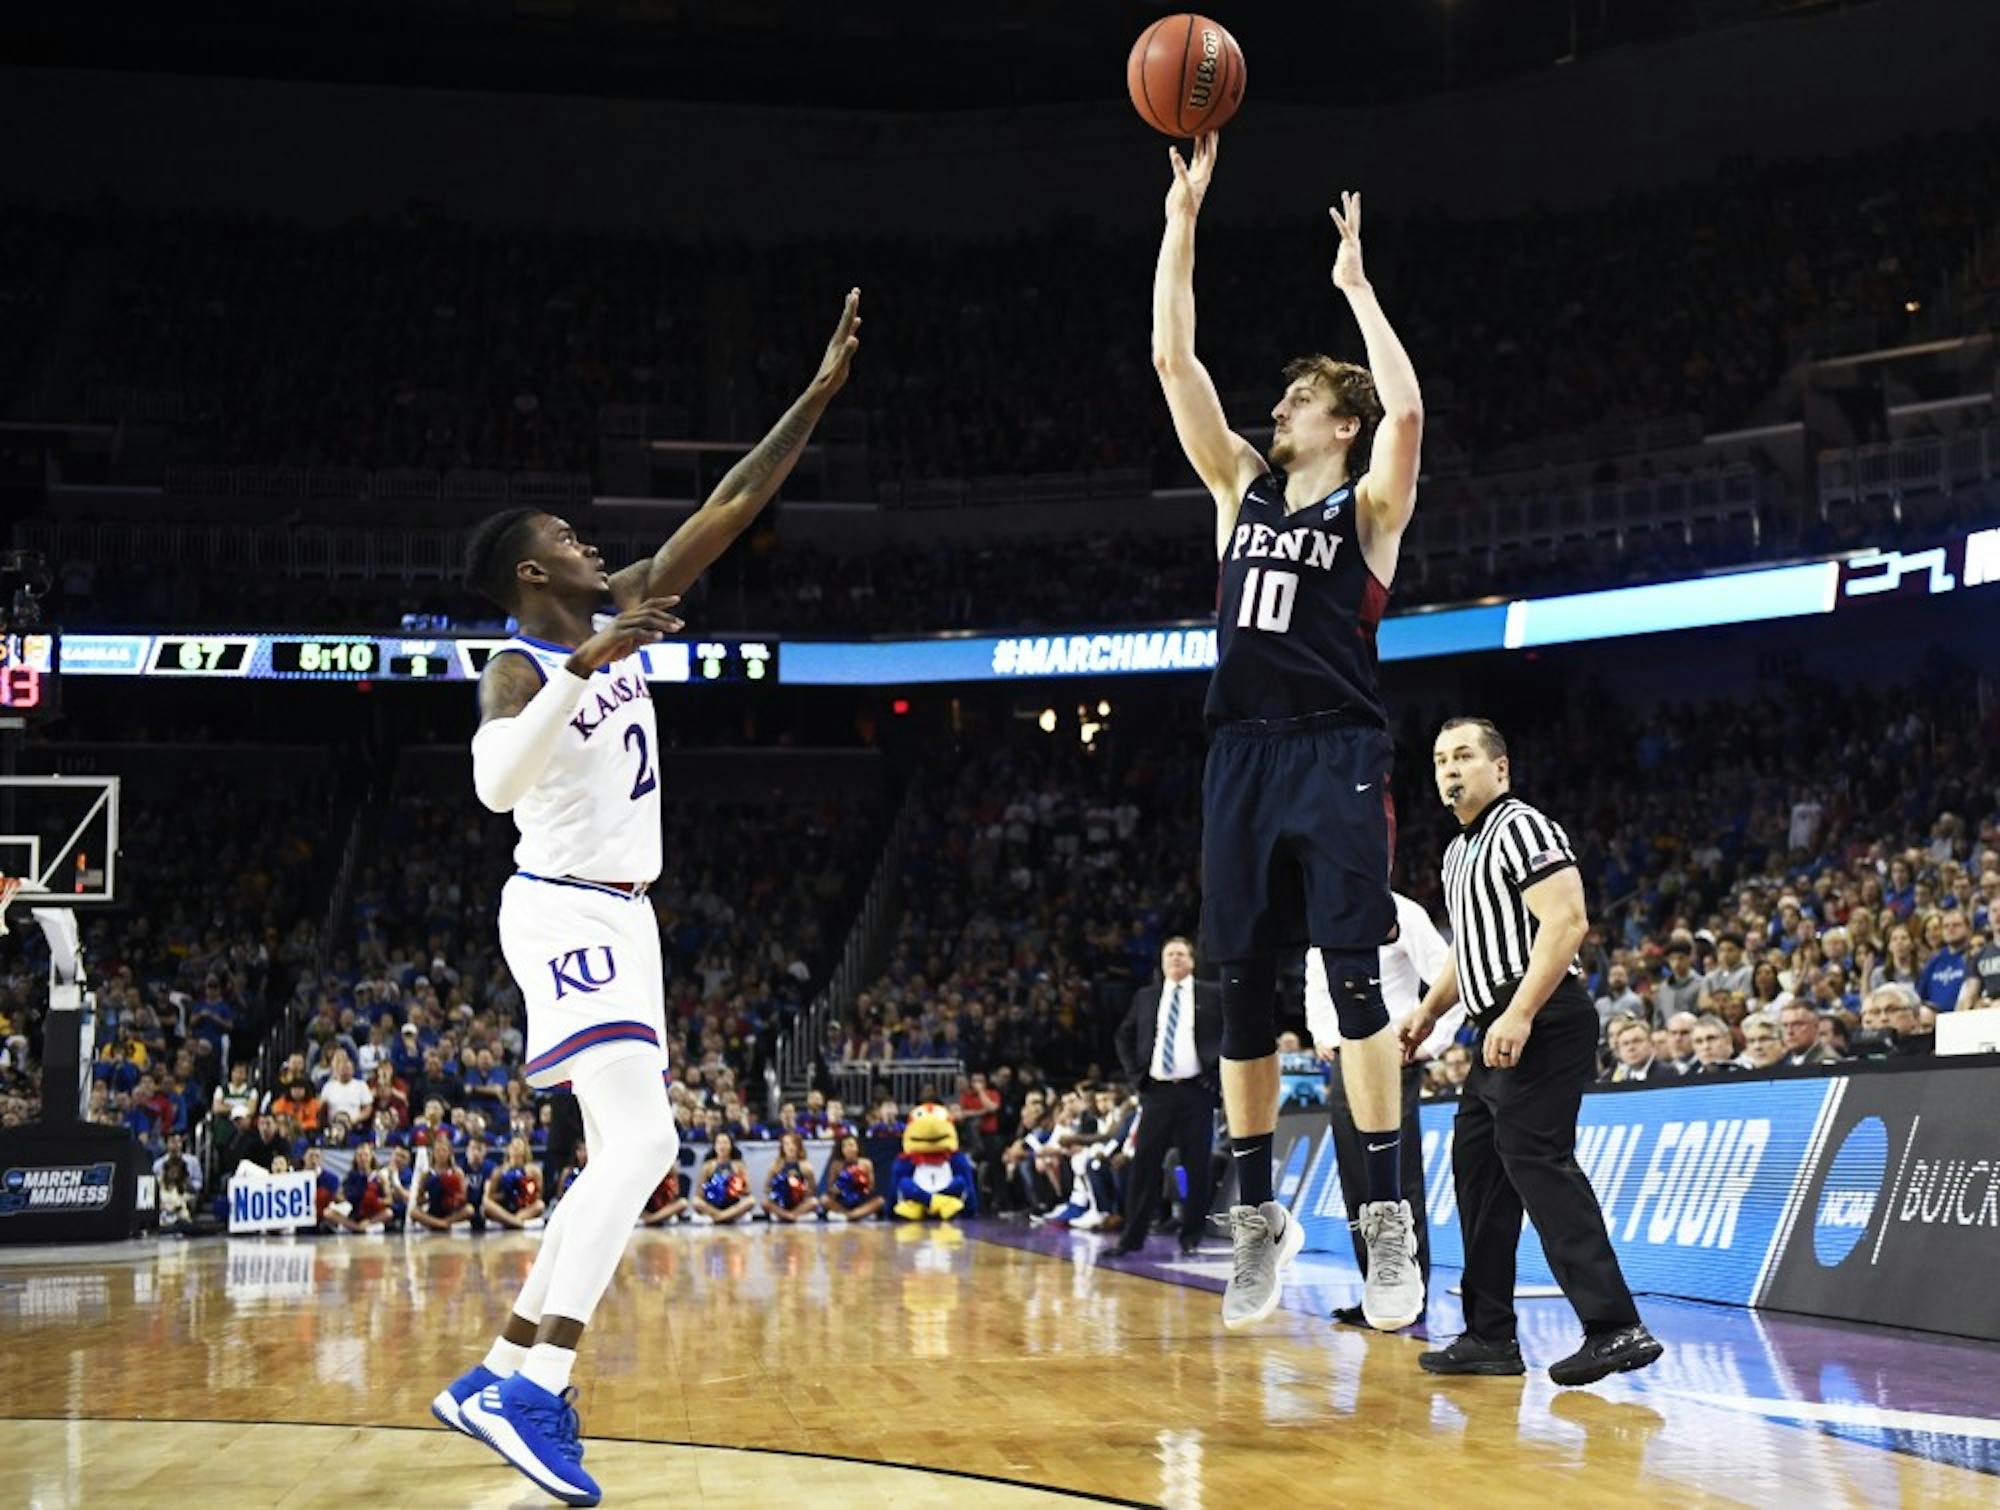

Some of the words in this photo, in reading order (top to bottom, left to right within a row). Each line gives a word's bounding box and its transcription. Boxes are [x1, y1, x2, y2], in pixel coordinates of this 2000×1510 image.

[1190, 30, 1218, 108] Wilson
[1231, 522, 1344, 572] PENN
[1237, 566, 1300, 634] 10
[179, 642, 226, 671] 67
[299, 643, 374, 673] 5:10
[623, 723, 657, 800] 2
[548, 946, 617, 1000] KU
[23, 1170, 84, 1189] MARCH
[28, 1184, 110, 1206] MADNESS
[235, 1181, 311, 1222] Noise!
[1622, 1119, 1771, 1249] FOUR
